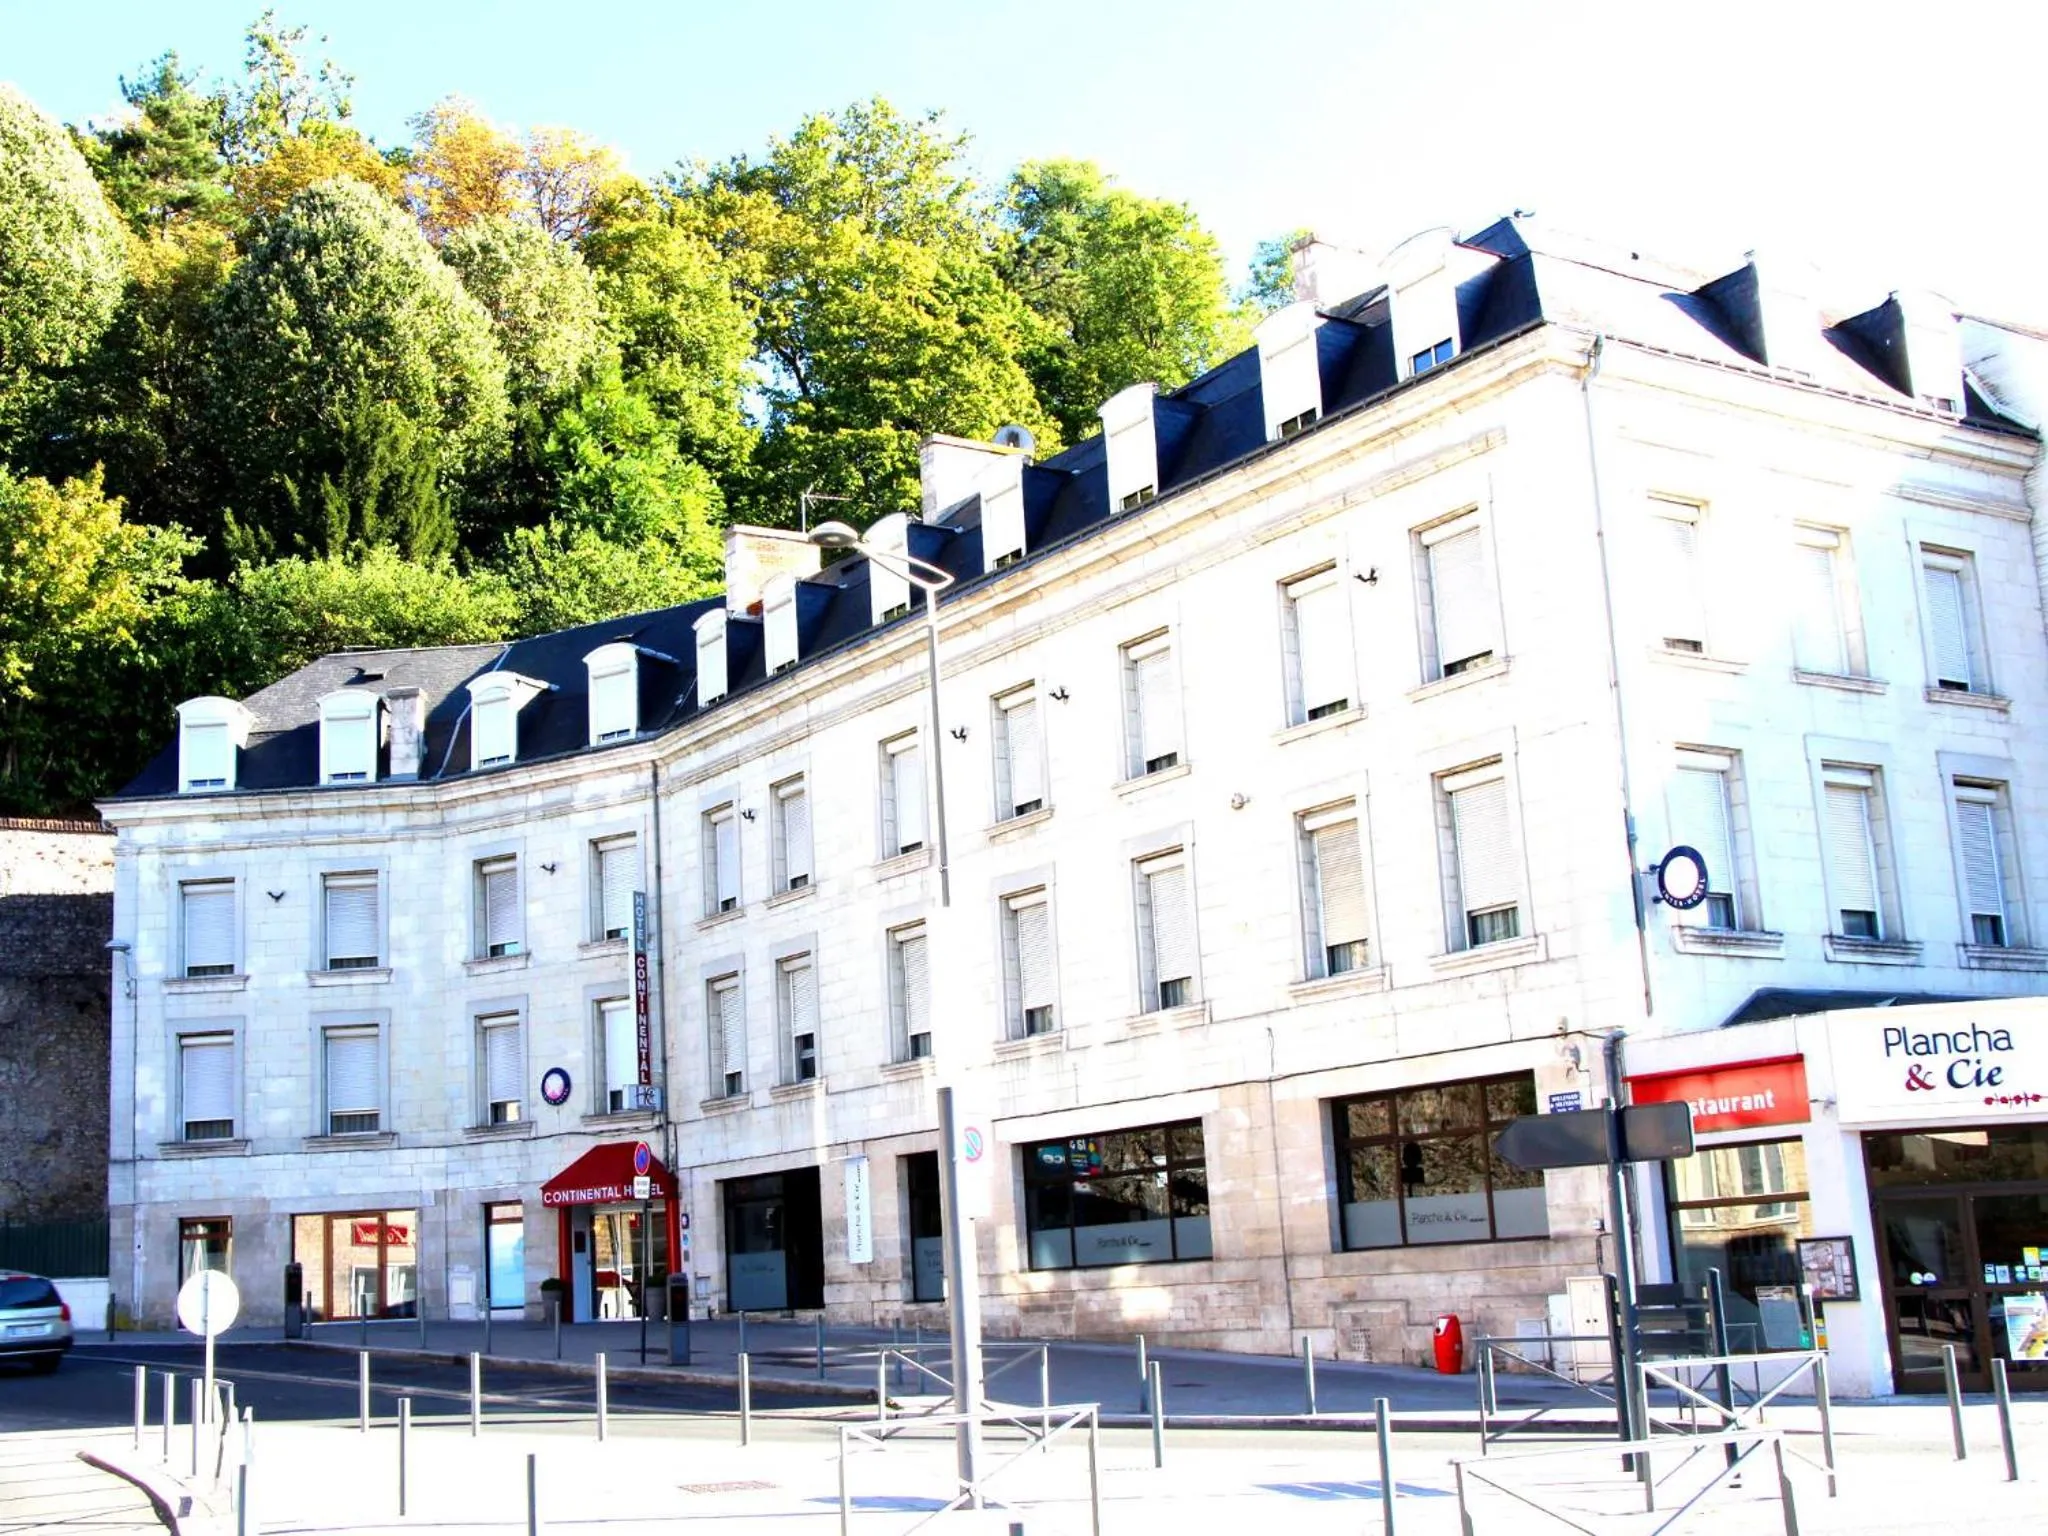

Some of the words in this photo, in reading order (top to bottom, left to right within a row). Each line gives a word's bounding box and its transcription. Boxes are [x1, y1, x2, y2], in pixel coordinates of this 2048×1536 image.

[635, 894, 644, 951] HOTEL
[637, 956, 648, 1082] CONTINENTAL
[1883, 1022, 2014, 1057] Plancha
[1905, 1063, 1936, 1091] &
[1946, 1058, 2003, 1089] Cie
[1691, 1089, 1775, 1116] staurant
[544, 1187, 621, 1203] CONTINENTAL
[624, 1184, 664, 1196] HEL
